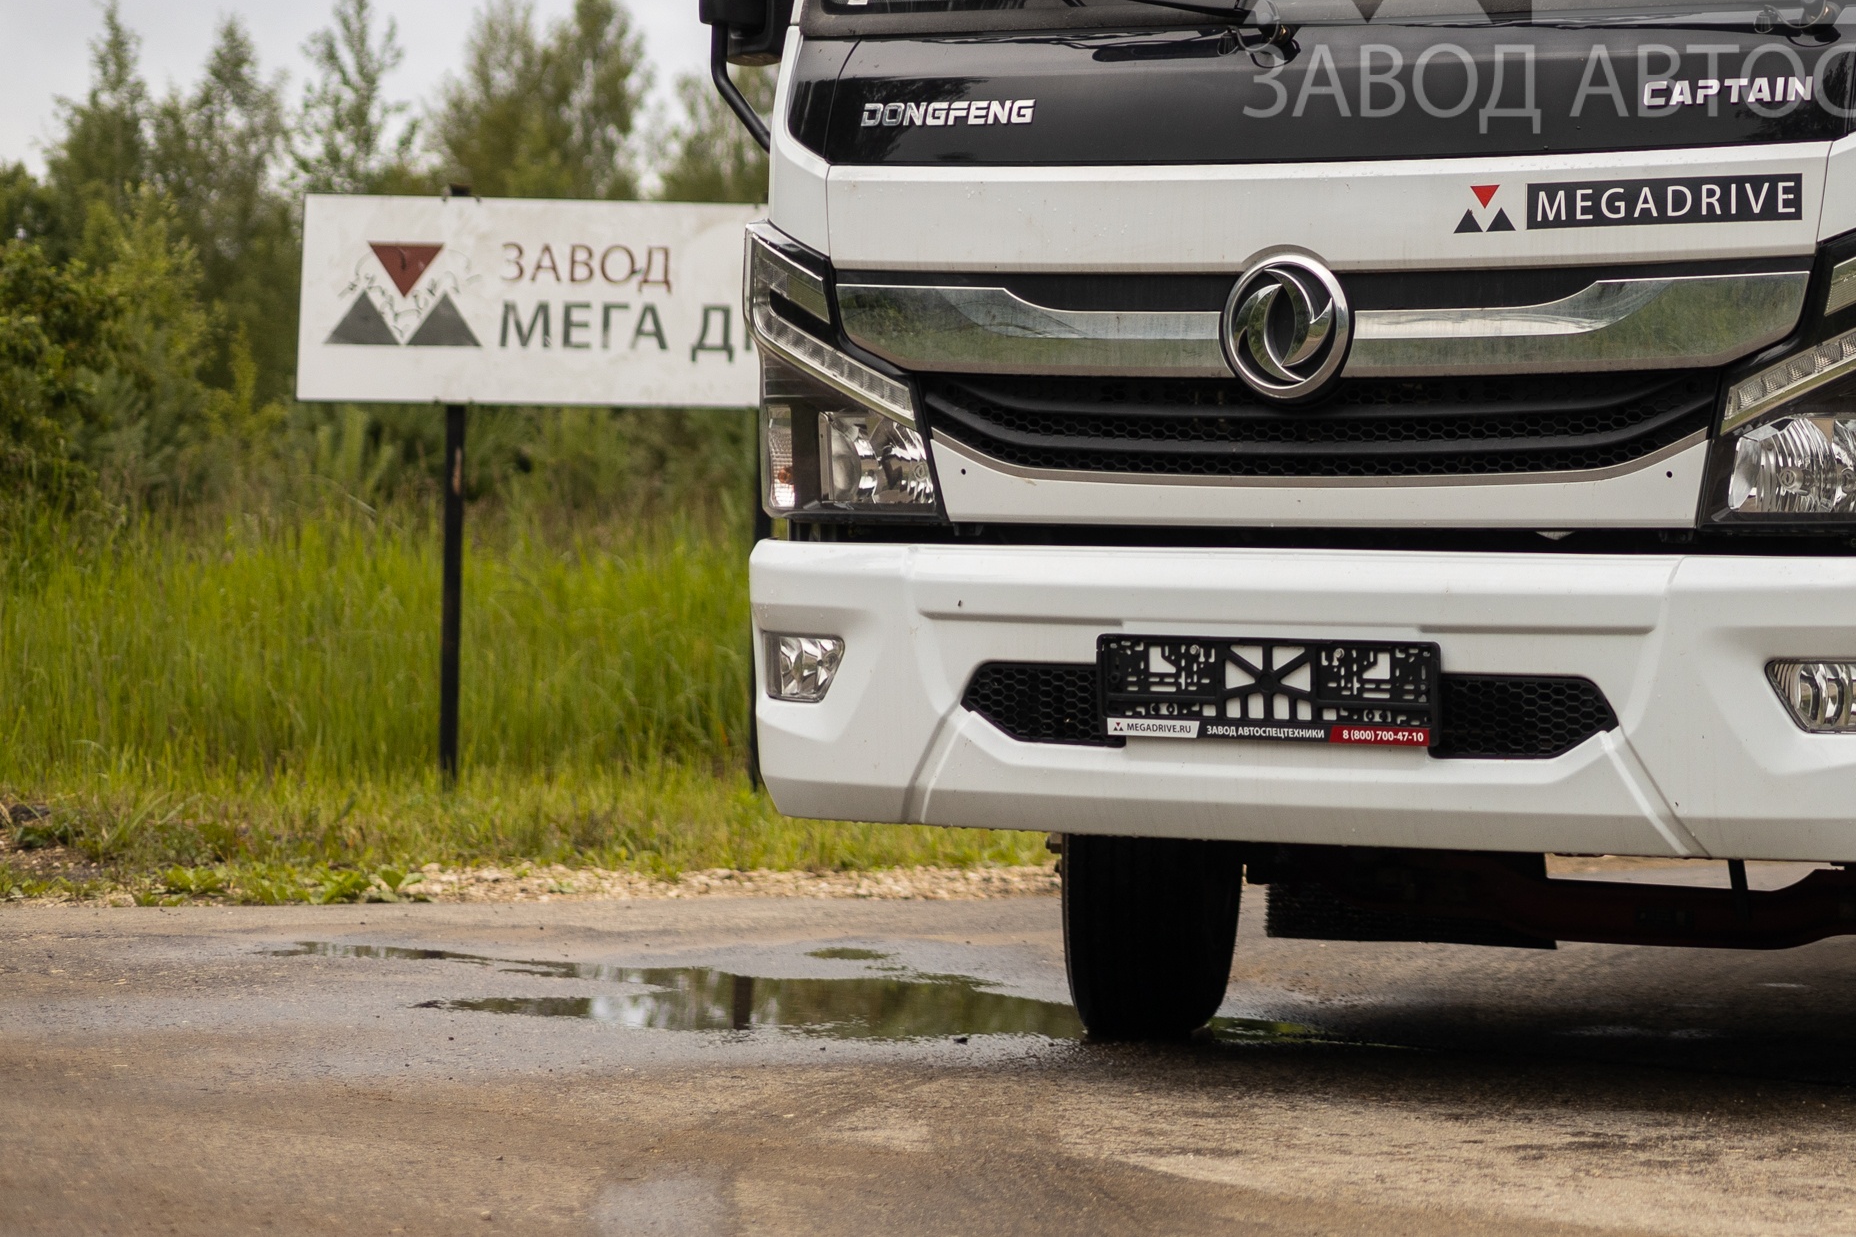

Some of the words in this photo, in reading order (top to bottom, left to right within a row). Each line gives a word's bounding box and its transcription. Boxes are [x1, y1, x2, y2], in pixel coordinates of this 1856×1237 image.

[1643, 76, 1814, 106] CAPTAIN
[861, 99, 1036, 127] DONGFENG
[1536, 181, 1796, 222] MEGADRIVE
[500, 241, 672, 295] ЗАВОД
[500, 300, 670, 351] МЕГА
[1126, 722, 1192, 734] MEGADRIVE.RU
[1206, 725, 1237, 737] ЗАВОД
[1237, 726, 1325, 739] АВТОСПЕЦТЕХНИКИ
[1342, 729, 1350, 740] 8
[1350, 729, 1375, 742] (800)
[1376, 730, 1424, 743] 700-47-10
